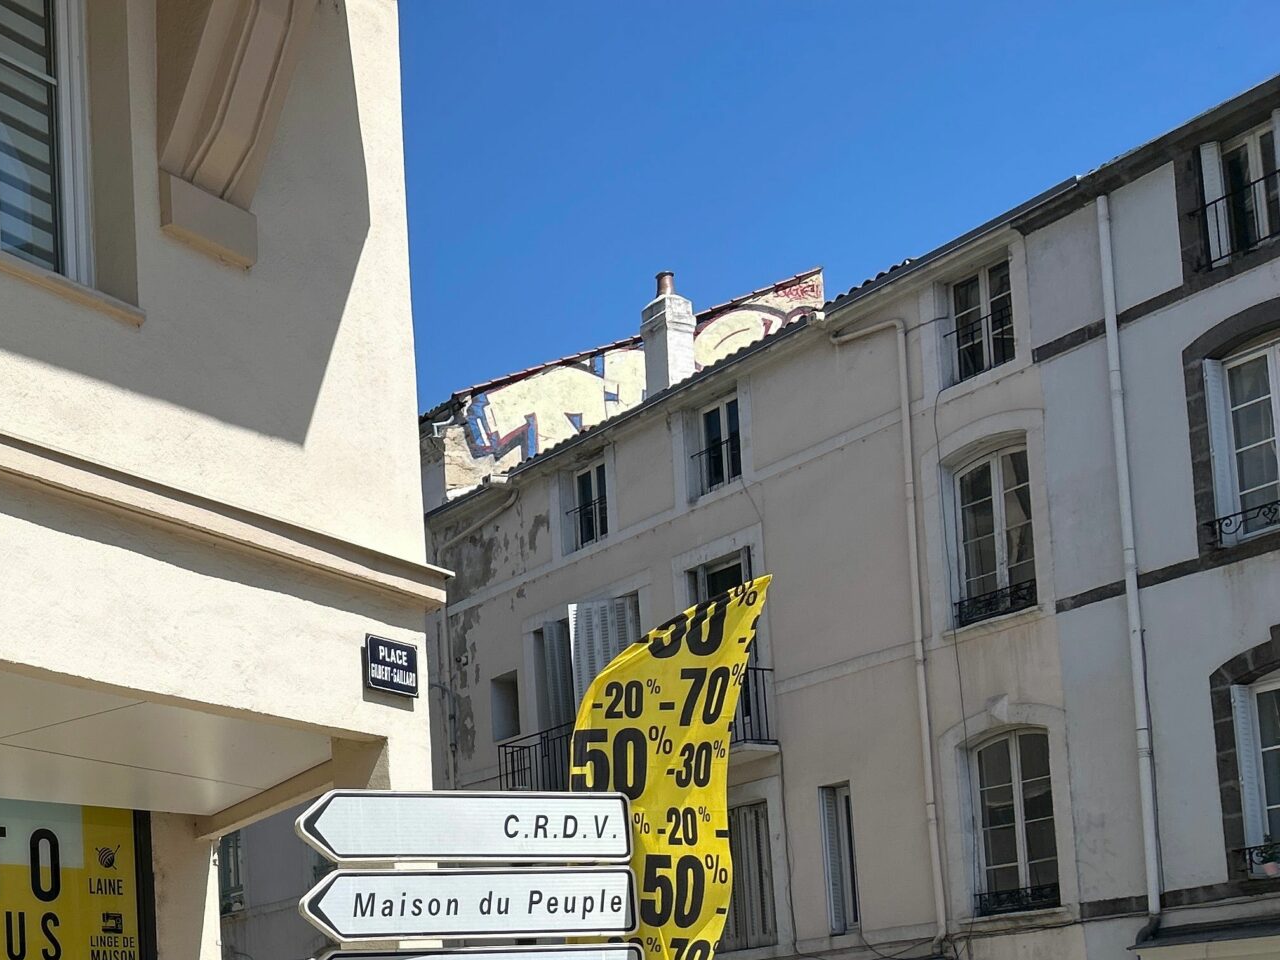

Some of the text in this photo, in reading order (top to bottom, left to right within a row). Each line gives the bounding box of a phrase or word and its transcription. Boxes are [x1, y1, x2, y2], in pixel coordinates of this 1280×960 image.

[378, 645, 408, 666] PLACE
[592, 678, 661, 719] -20%
[659, 663, 745, 728] -70%
[666, 739, 726, 788] -30%
[503, 814, 618, 840] C.R.D.V.
[657, 806, 711, 846] -20%
[89, 878, 123, 896] LAINE
[353, 889, 623, 920] Maison du Peuple
[90, 935, 135, 949] LINGE DE
